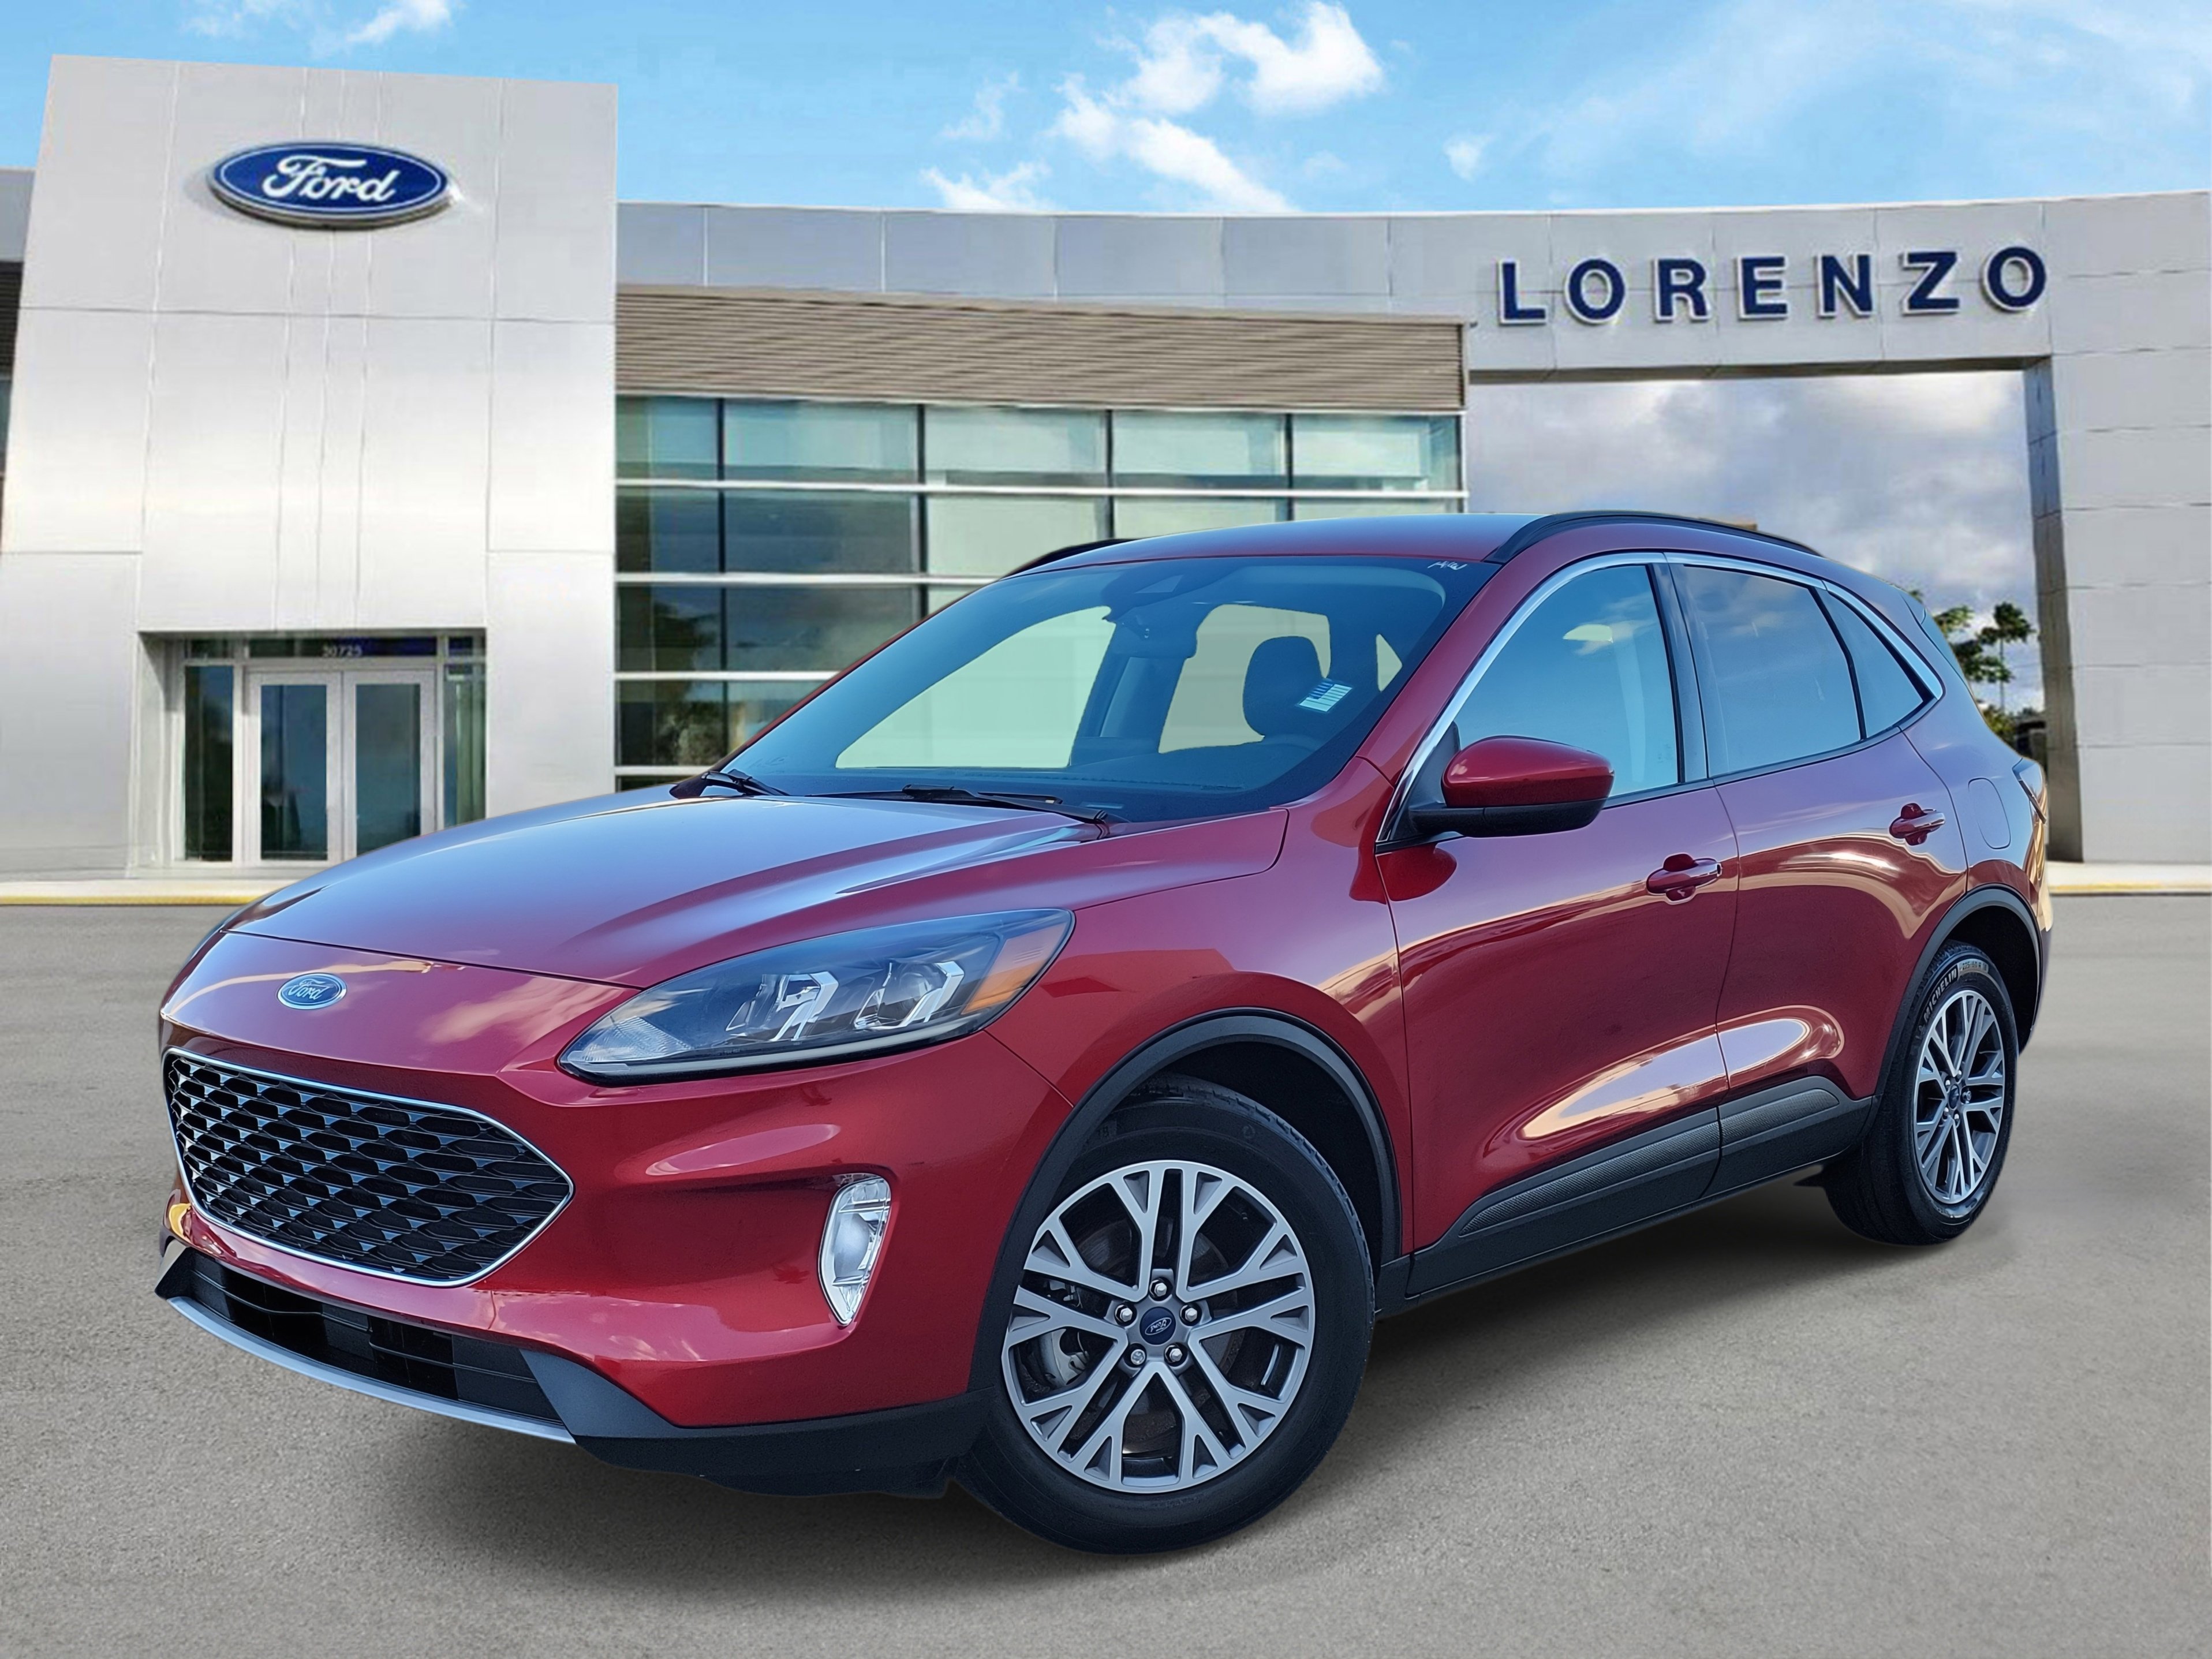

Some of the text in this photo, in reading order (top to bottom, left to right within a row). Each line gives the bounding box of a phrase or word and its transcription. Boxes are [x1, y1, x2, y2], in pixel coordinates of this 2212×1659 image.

[261, 154, 400, 202] Ford
[1497, 246, 2047, 325] LORENZO
[287, 978, 330, 1000] Ford
[1923, 967, 1957, 1023] MICHELIN
